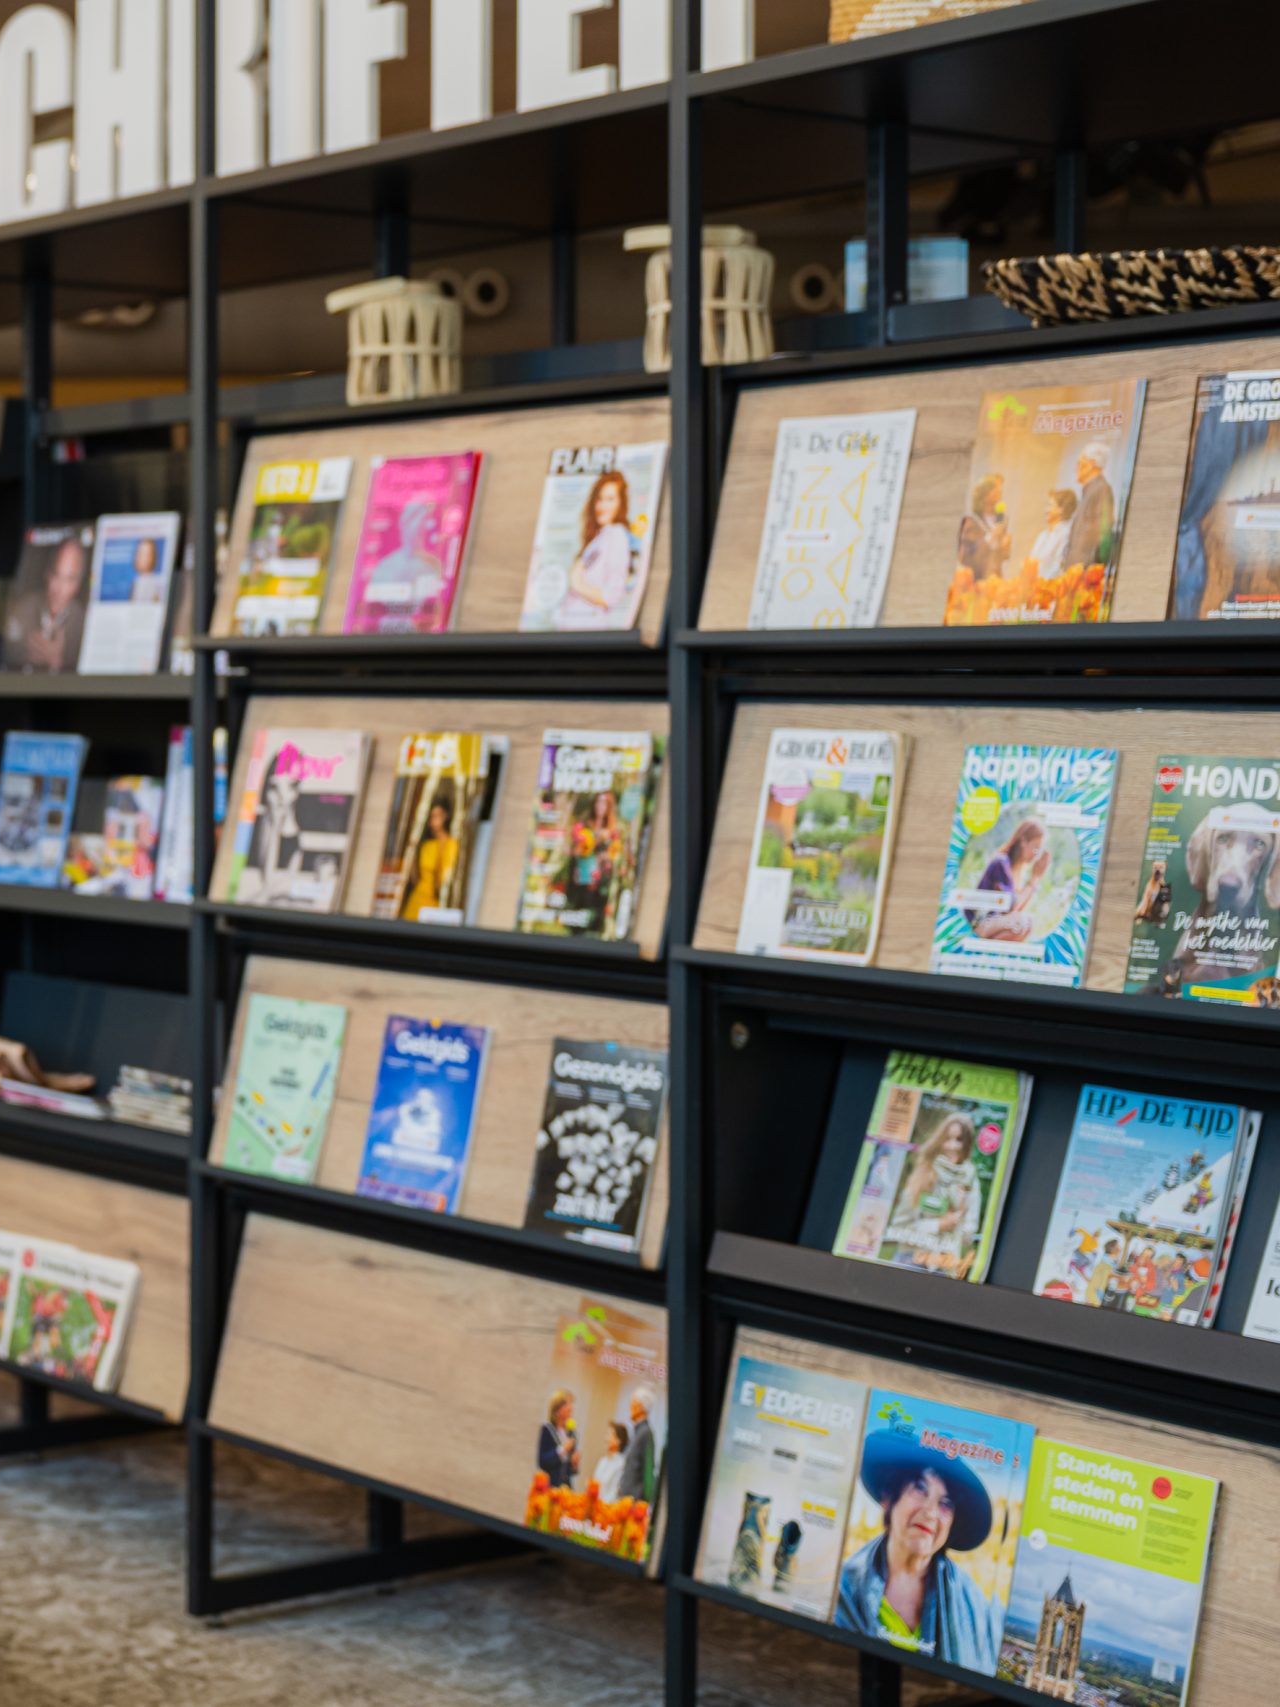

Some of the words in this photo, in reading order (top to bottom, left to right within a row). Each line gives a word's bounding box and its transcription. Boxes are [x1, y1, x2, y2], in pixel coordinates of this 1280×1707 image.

[1223, 381, 1247, 402] DE
[1220, 401, 1280, 423] AMSTE
[550, 447, 615, 476] FLAIR
[1183, 765, 1280, 800] HOND
[1173, 911, 1193, 931] De
[1195, 910, 1239, 936] mythe
[1245, 917, 1270, 930] van
[1183, 932, 1207, 952] het
[920, 1428, 1005, 1460] Magazine
[1056, 1452, 1138, 1490] Standen,
[1053, 1475, 1115, 1503] steden
[1119, 1491, 1144, 1512] en
[1050, 1495, 1137, 1531] stemmen
